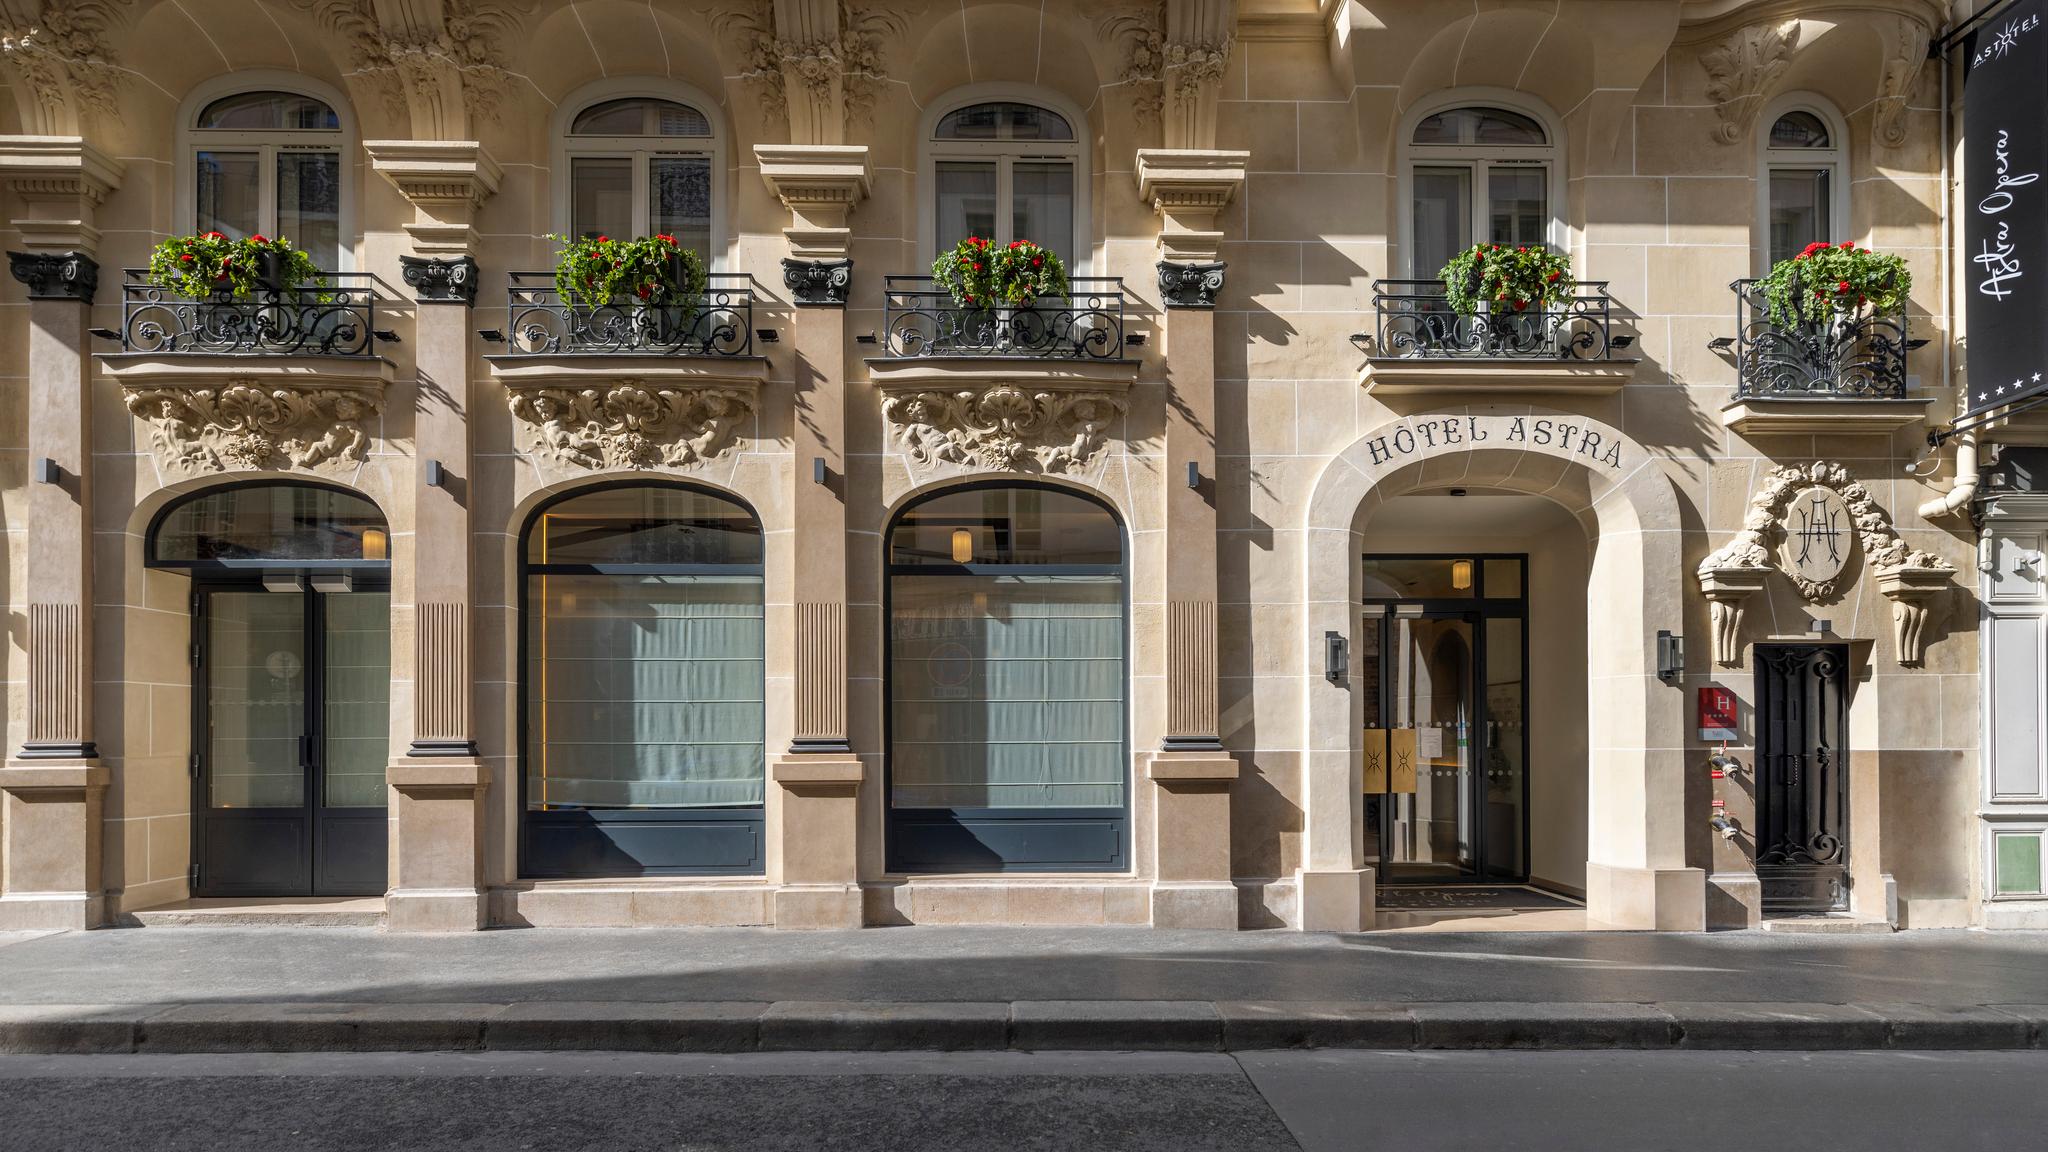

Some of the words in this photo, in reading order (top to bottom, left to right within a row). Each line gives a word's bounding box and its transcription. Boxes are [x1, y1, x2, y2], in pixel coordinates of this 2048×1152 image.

[1978, 129, 2040, 215] Opera
[1973, 221, 2023, 302] Astra
[1366, 416, 1488, 466] HÔTEL
[1506, 416, 1622, 470] ASTRA
